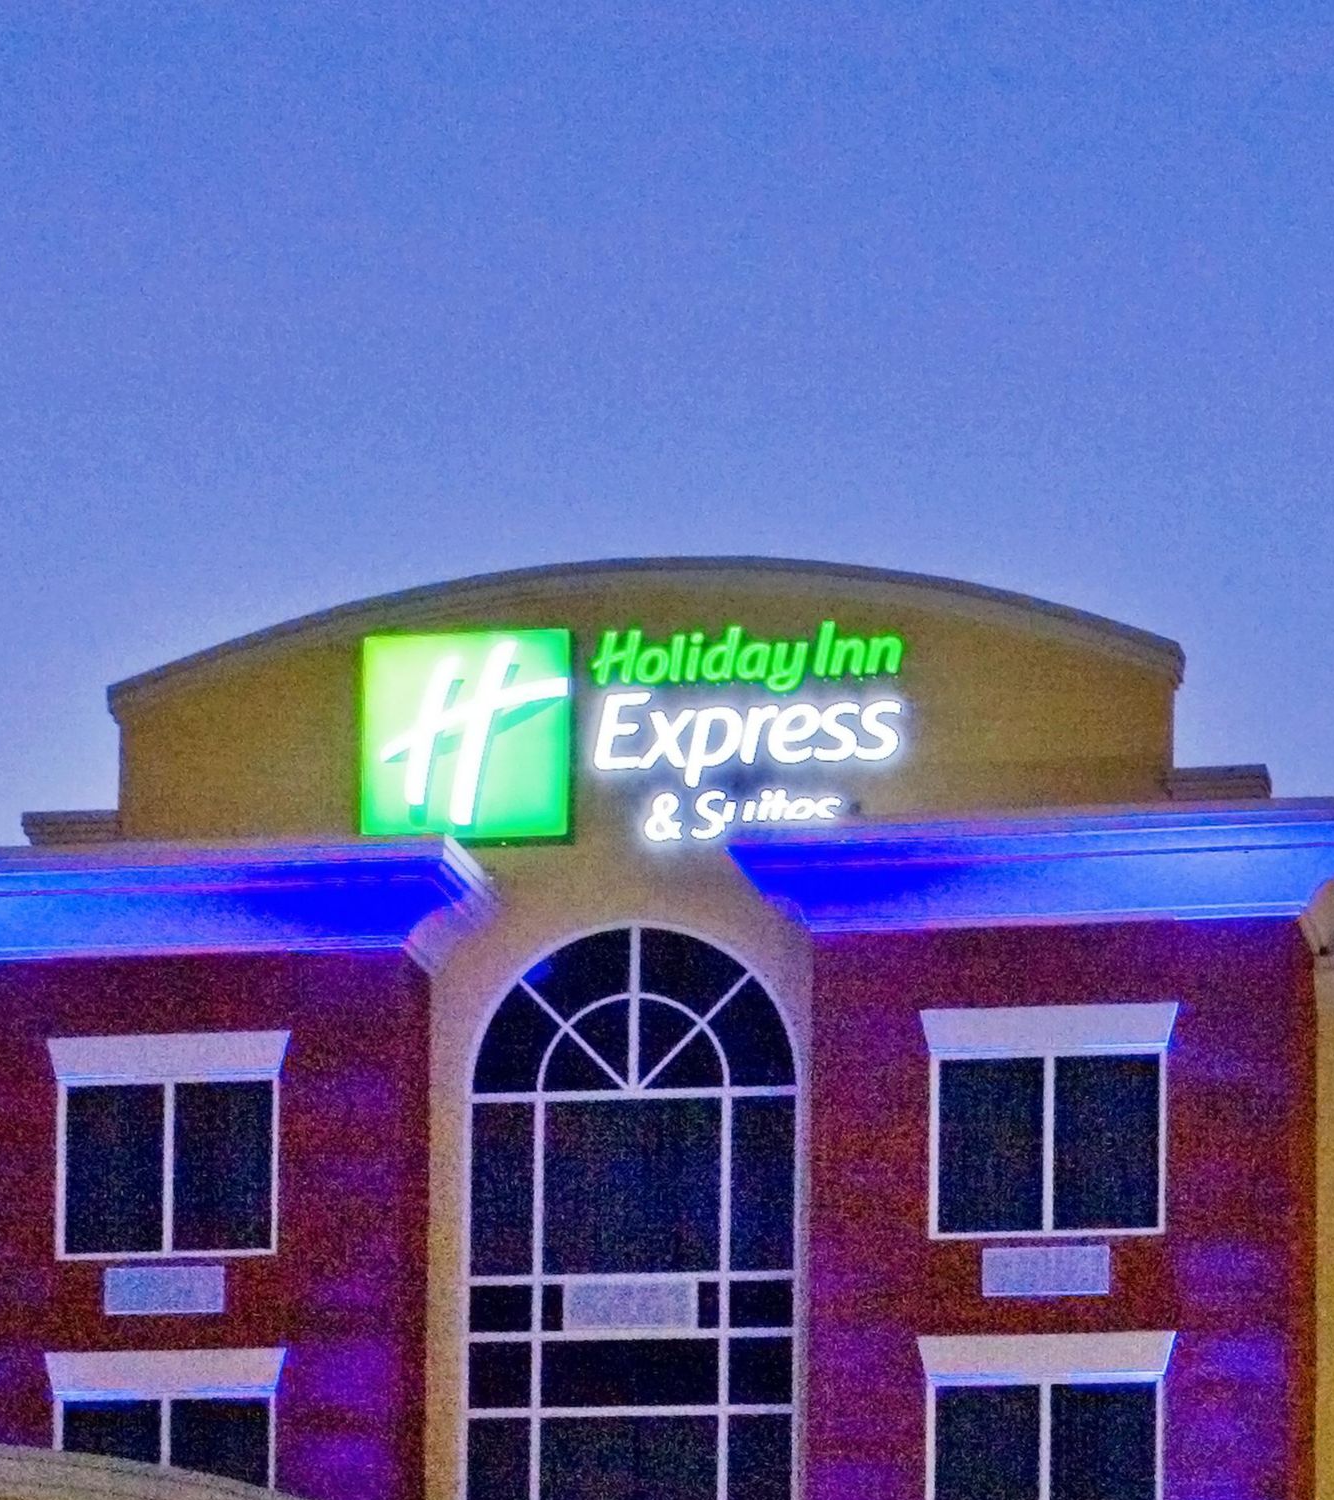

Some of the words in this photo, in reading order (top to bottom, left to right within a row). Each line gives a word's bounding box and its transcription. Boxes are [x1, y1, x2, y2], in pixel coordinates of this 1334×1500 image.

[592, 626, 809, 692] Holiday
[813, 620, 903, 677] Inn
[593, 691, 903, 788] Express
[644, 792, 683, 841] &
